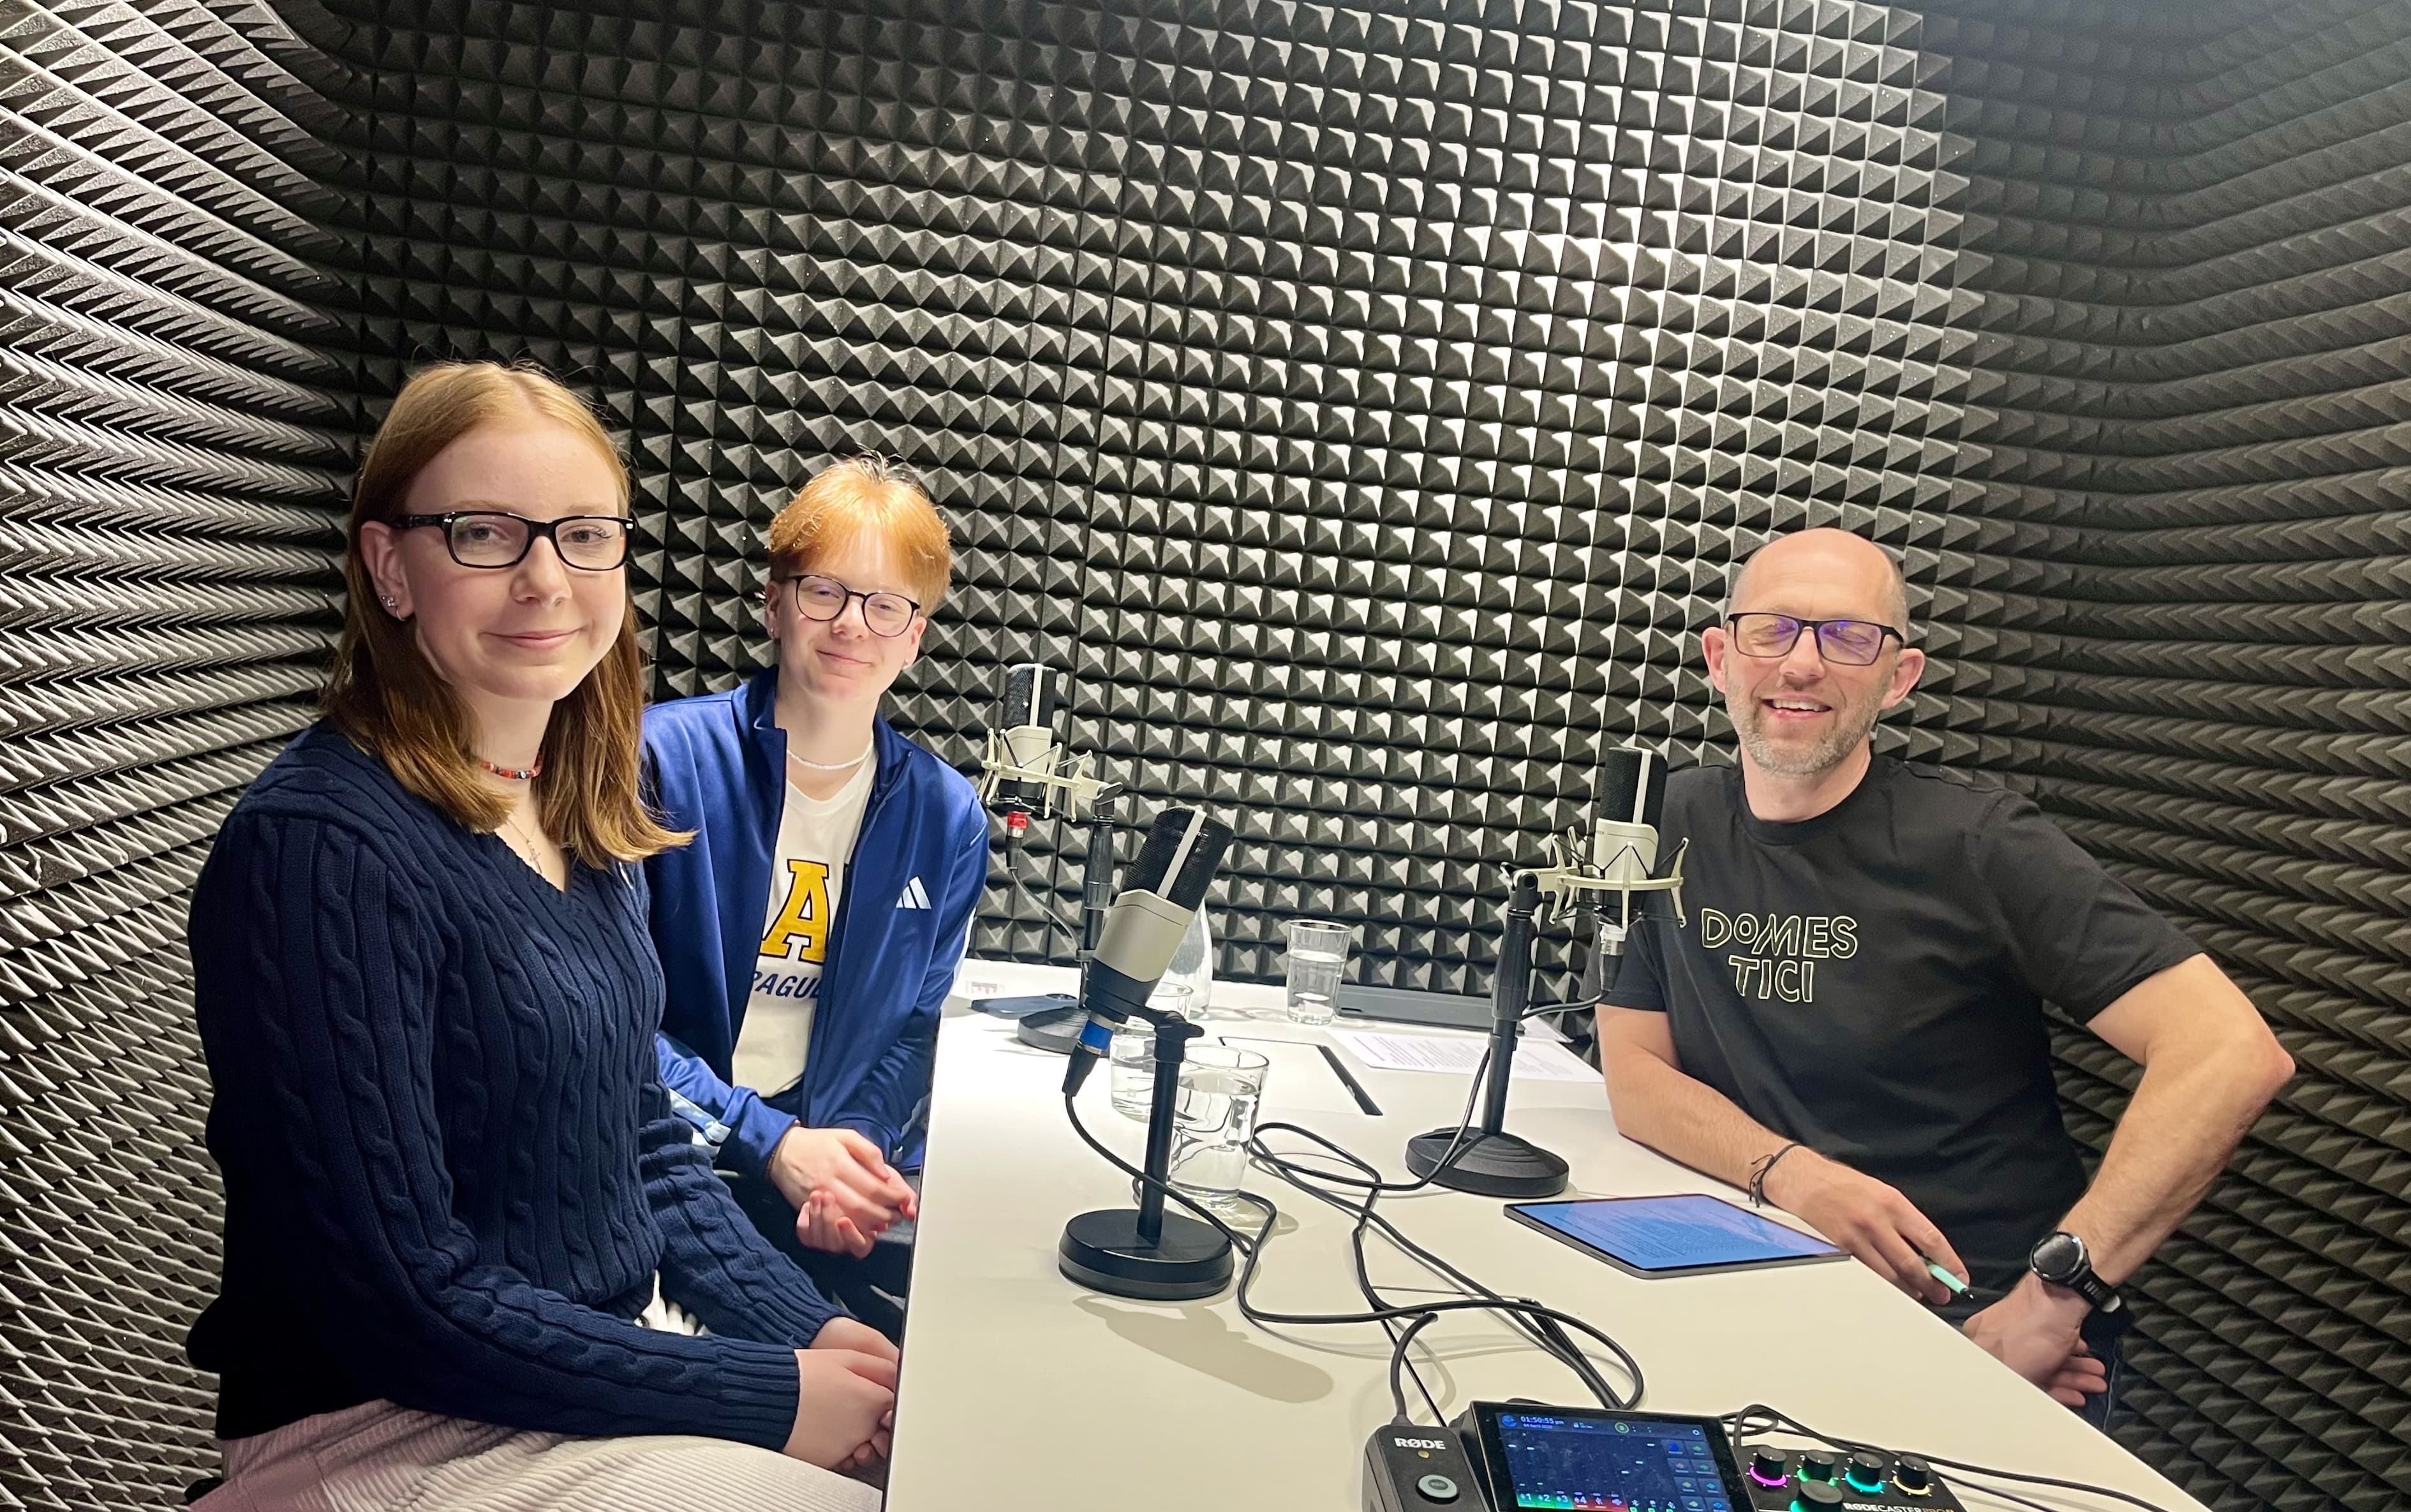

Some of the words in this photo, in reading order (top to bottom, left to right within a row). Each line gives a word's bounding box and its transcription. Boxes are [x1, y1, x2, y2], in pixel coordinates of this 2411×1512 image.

[1701, 907, 1858, 960] DOMES
[1728, 954, 1814, 1004] TICI
[1393, 1437, 1446, 1450] RØDE
[1543, 1494, 1551, 1502] 2
[1561, 1495, 1569, 1503] 3
